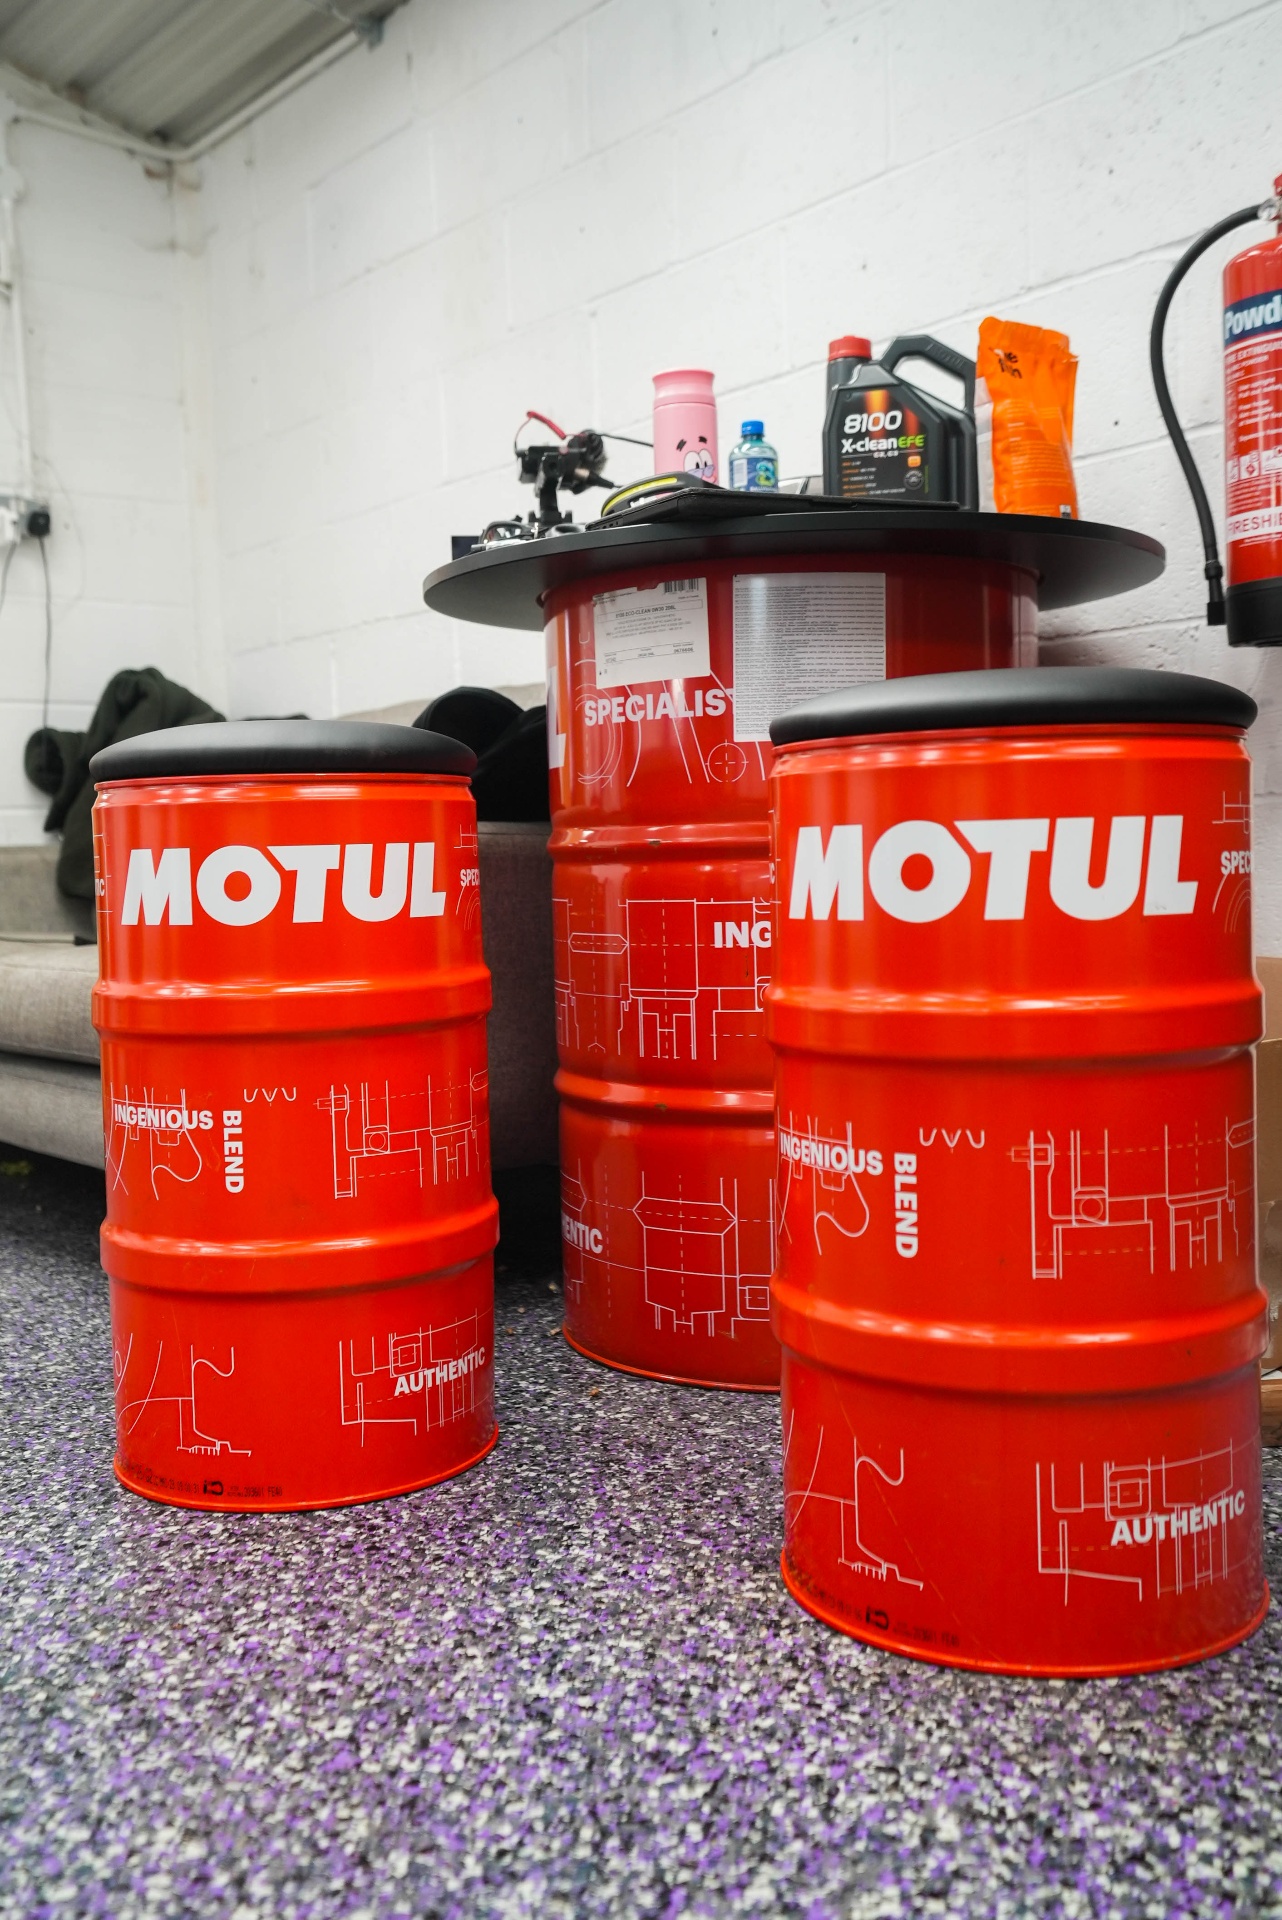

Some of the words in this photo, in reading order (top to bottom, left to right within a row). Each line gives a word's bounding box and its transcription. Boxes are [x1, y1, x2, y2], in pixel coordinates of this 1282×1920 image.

[843, 410, 903, 434] 8100
[584, 688, 733, 726] SPECIALIS
[121, 842, 446, 926] MOTUL
[788, 815, 1199, 923] MOTUL
[114, 1103, 213, 1130] INGENIOUS
[222, 1110, 245, 1194] BLEND
[780, 1132, 884, 1176] INGENIOUS
[894, 1152, 919, 1259] BLEND
[561, 1211, 603, 1254] ENTIC
[393, 1346, 486, 1397] AUTHENTIC
[1110, 1490, 1246, 1547] AUTHENTIC
